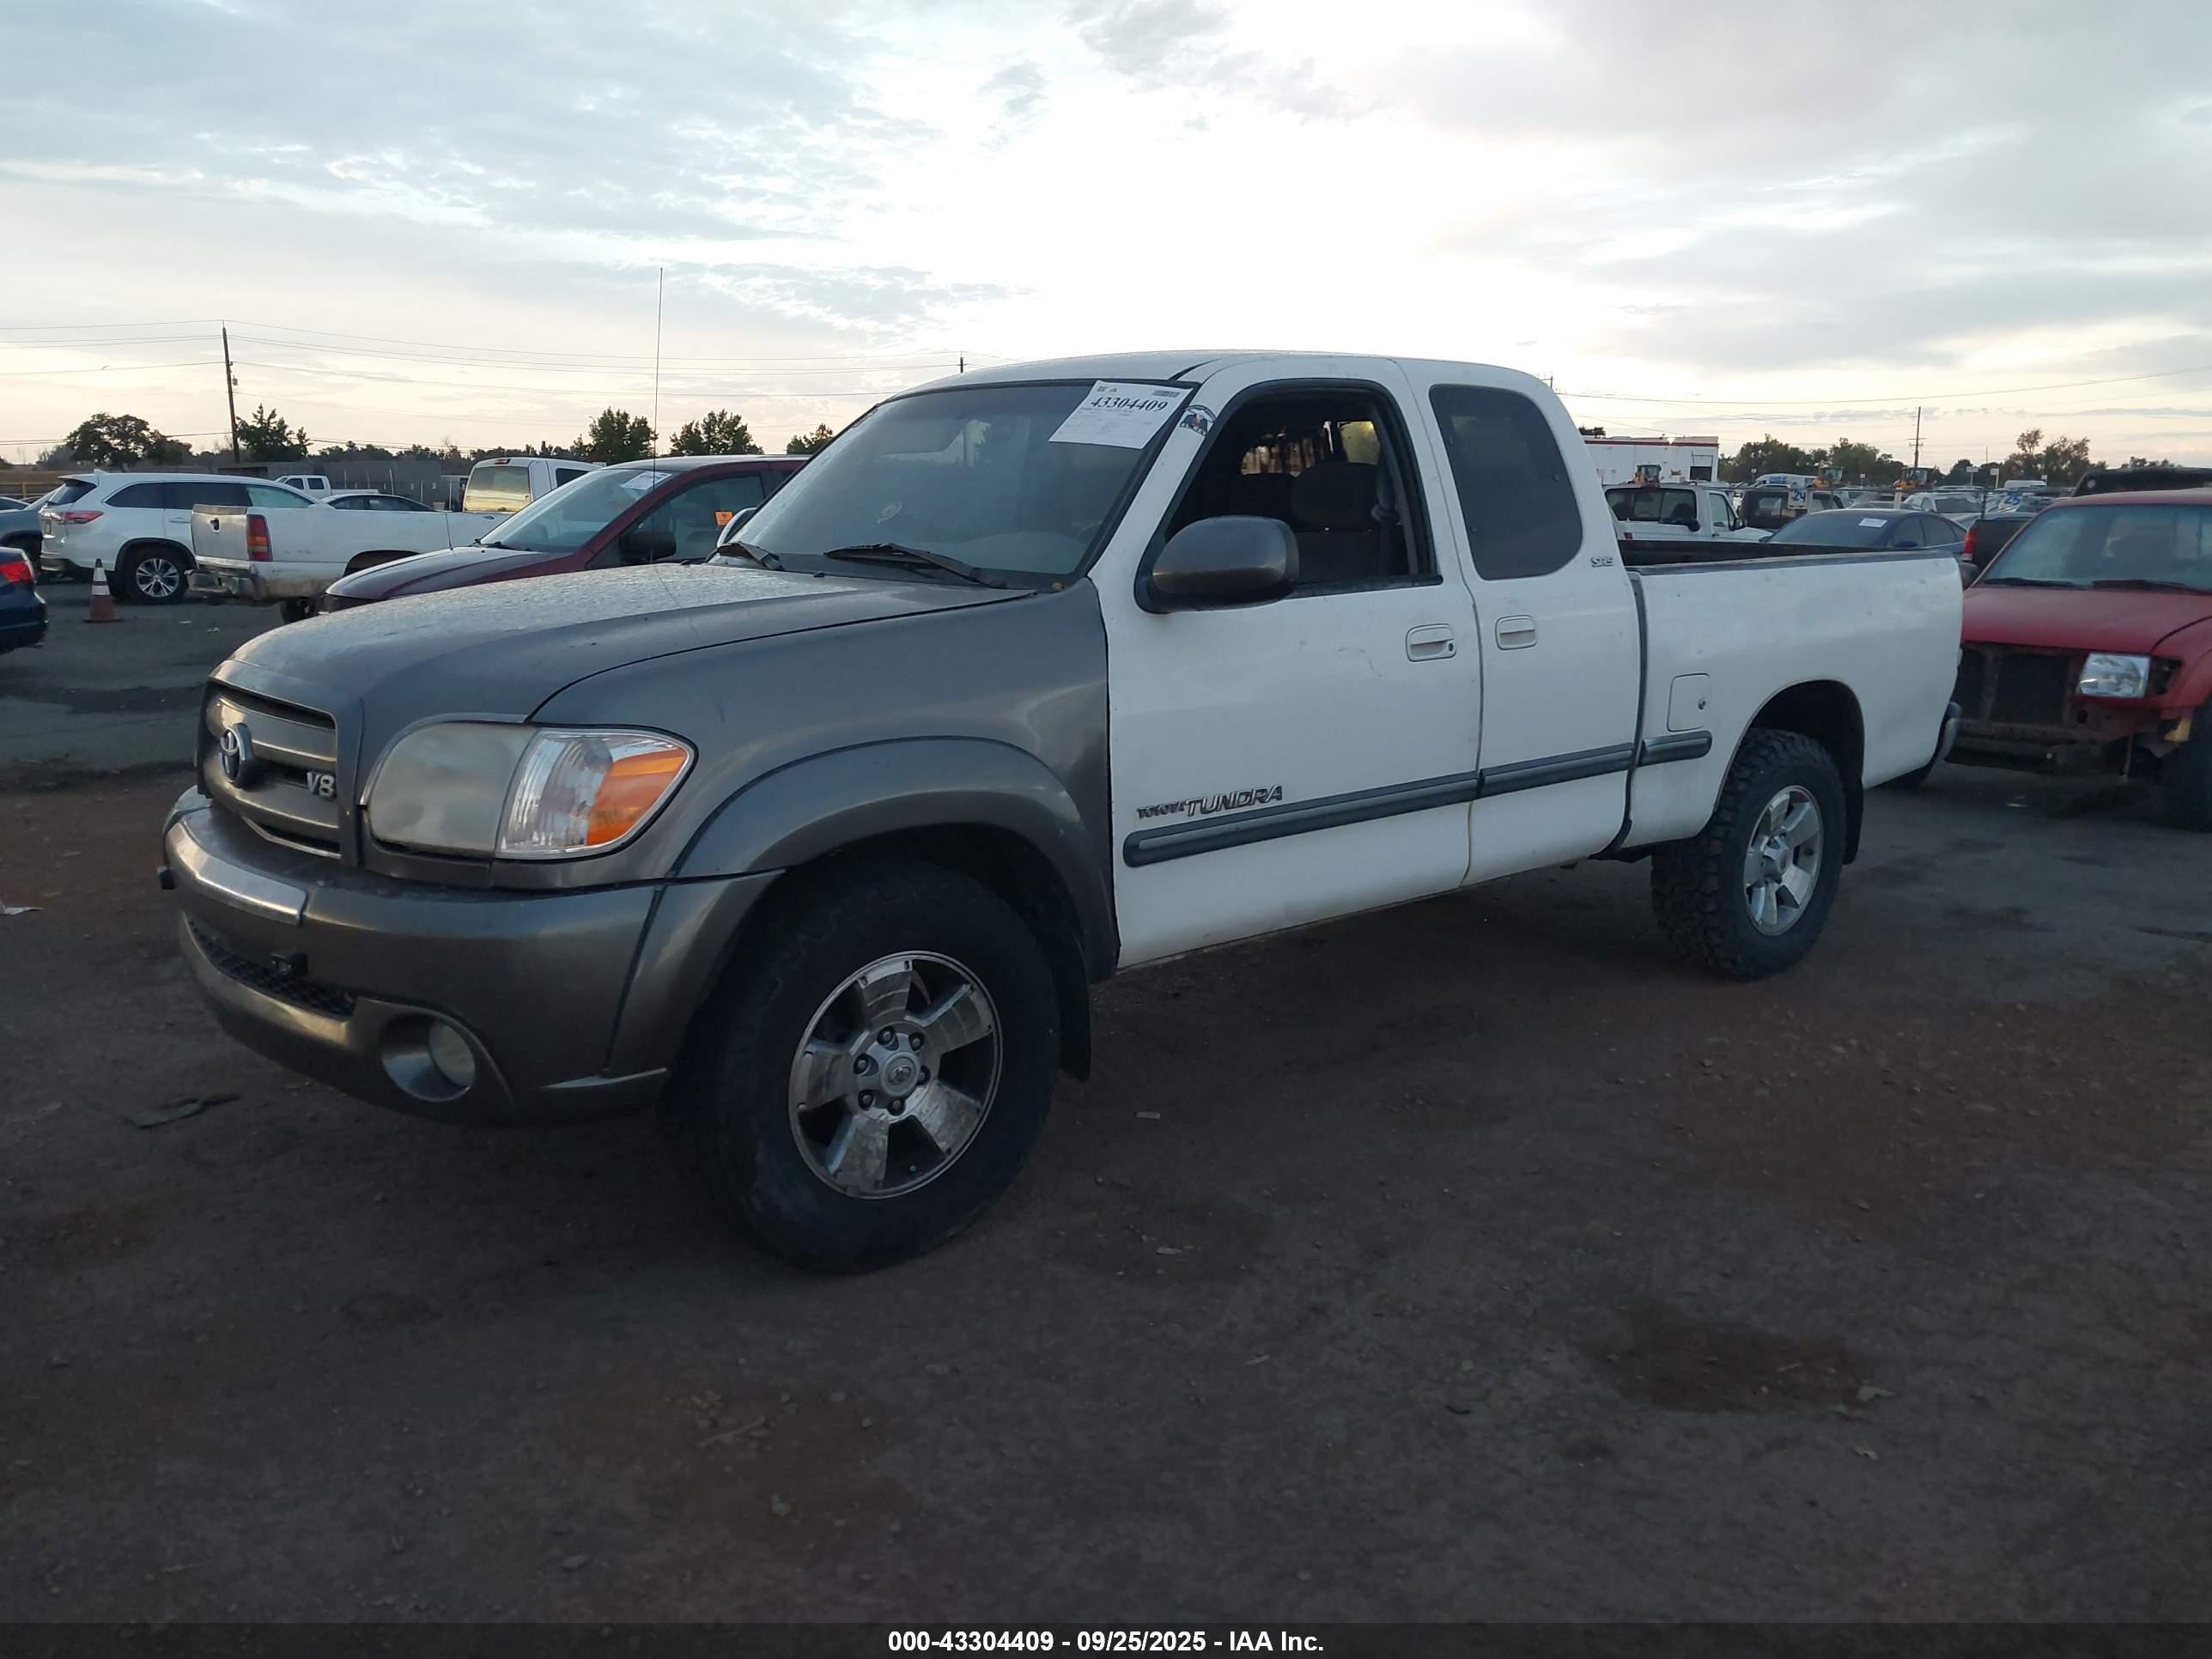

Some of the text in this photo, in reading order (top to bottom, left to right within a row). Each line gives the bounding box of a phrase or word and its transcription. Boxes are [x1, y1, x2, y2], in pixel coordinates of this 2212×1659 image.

[1091, 397, 1168, 411] 43304409
[307, 772, 335, 798] V8
[1186, 784, 1284, 817] TUNDRA
